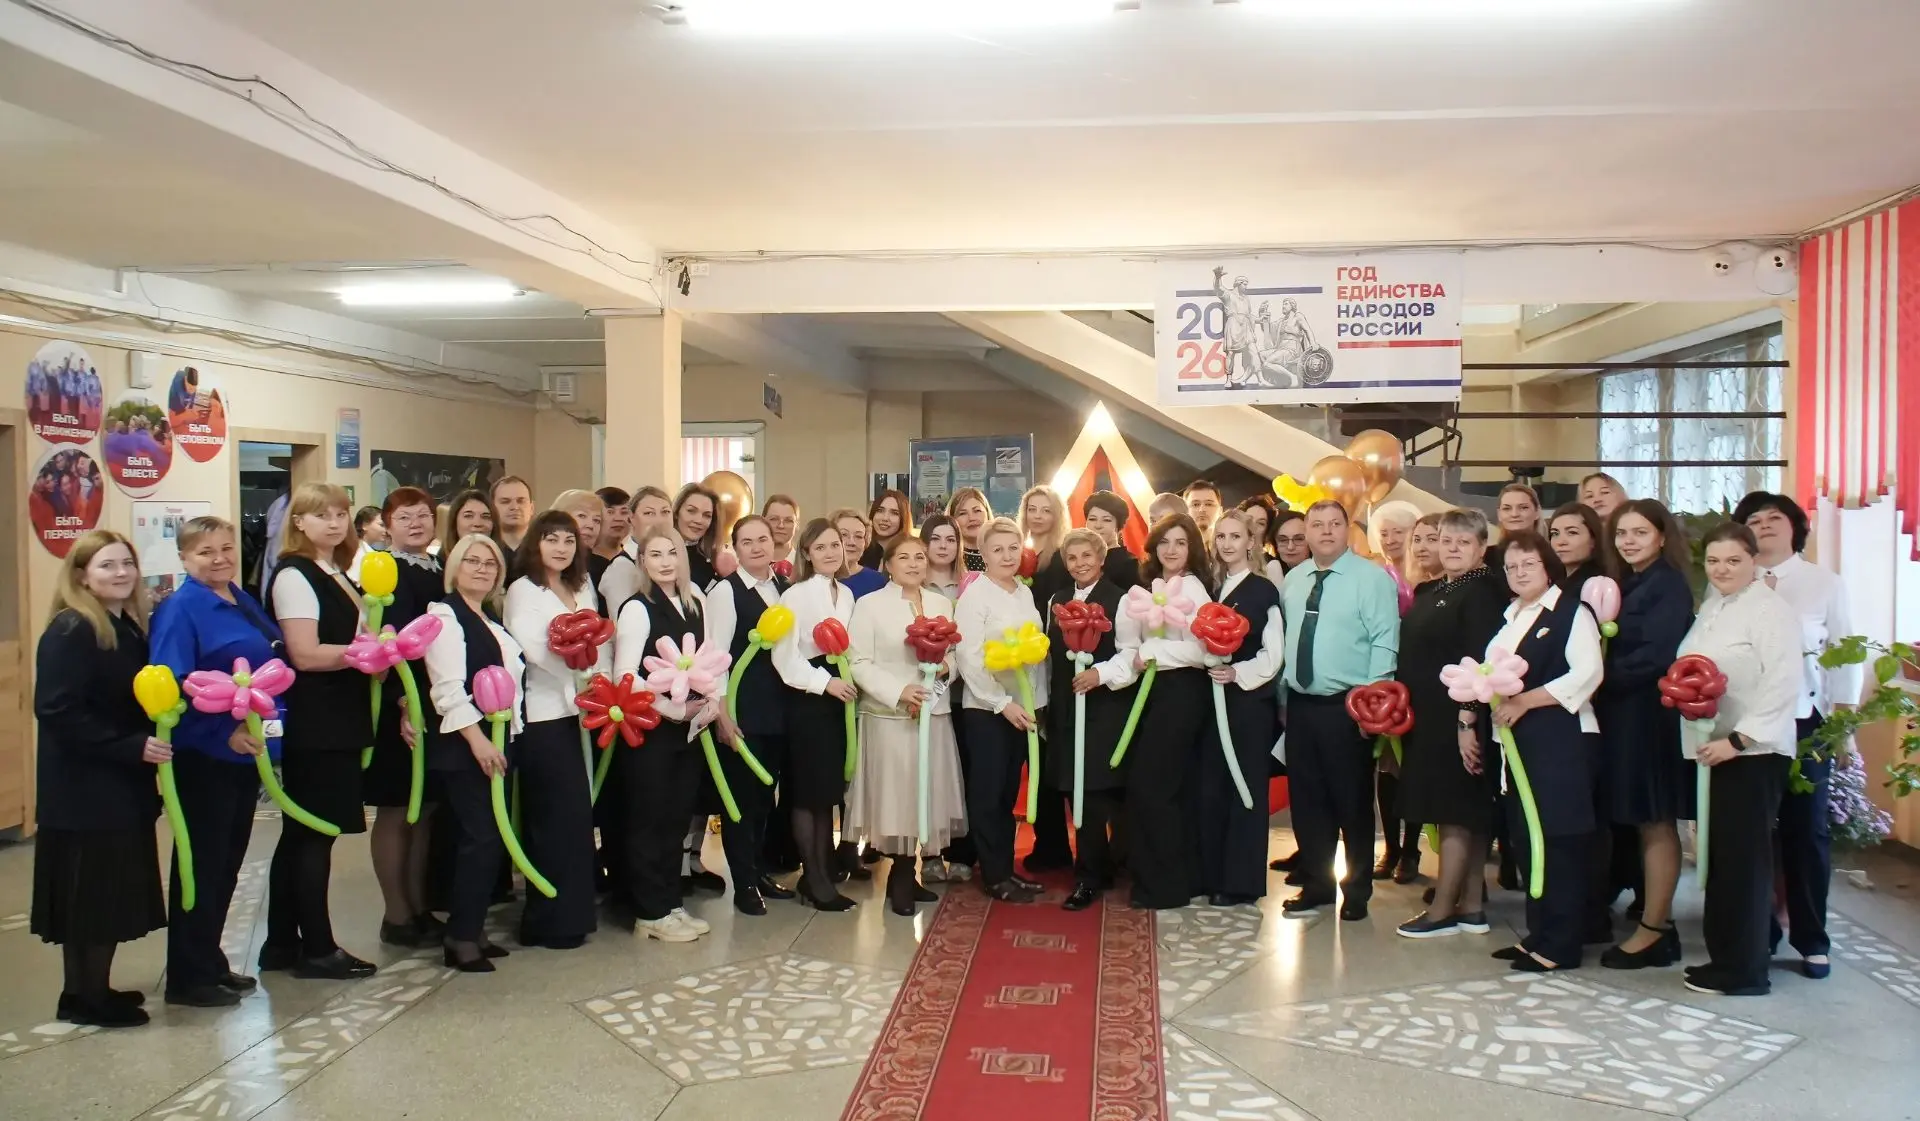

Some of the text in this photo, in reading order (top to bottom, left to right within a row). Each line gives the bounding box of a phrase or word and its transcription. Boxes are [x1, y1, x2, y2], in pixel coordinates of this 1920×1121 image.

[1337, 266, 1377, 282] ГОД
[1337, 284, 1446, 301] ЕДИНСТВА
[1337, 303, 1435, 319] НАРОДОВ
[1176, 302, 1225, 341] 20
[1337, 321, 1422, 337] РОССИИ
[1176, 342, 1226, 380] 26
[52, 413, 79, 425] БЫТЬ
[34, 424, 42, 434] В
[188, 423, 212, 433] БЫТЬ
[127, 456, 153, 467] БЫТЬ
[122, 468, 159, 479] ВМЕСТЕ
[55, 516, 83, 526] БЫТЬ
